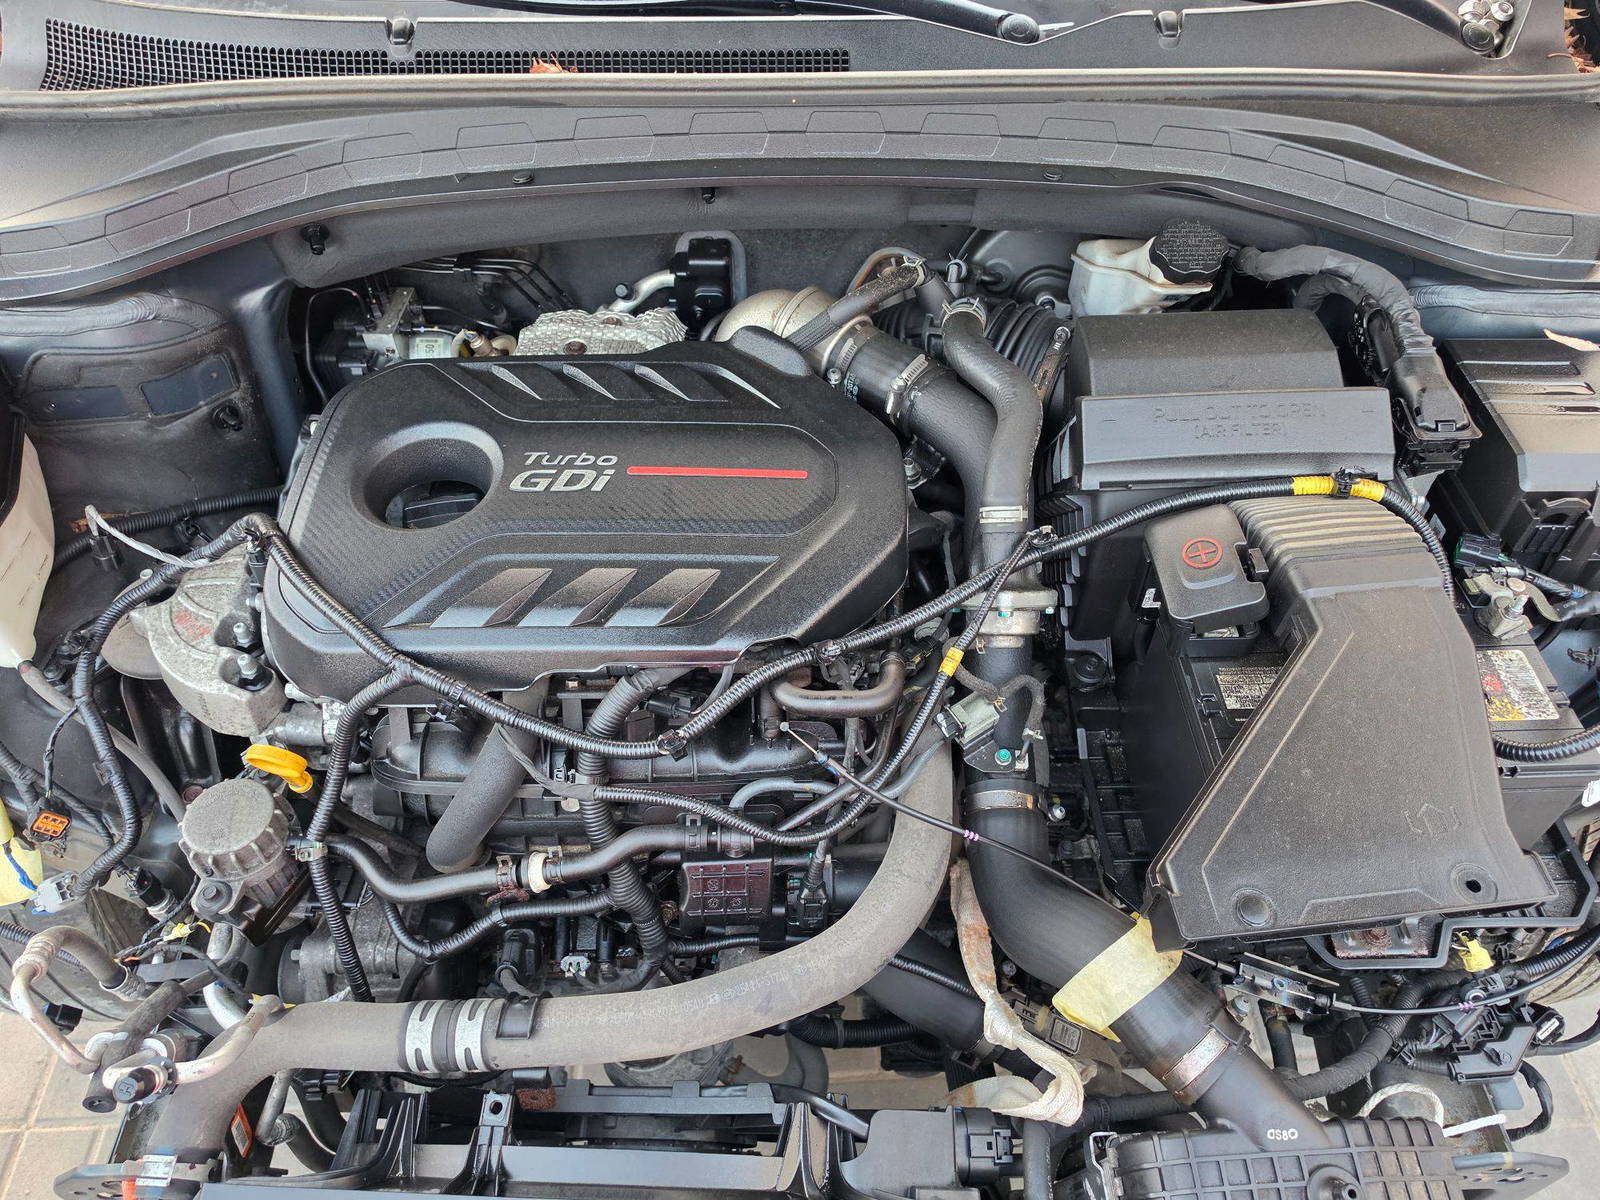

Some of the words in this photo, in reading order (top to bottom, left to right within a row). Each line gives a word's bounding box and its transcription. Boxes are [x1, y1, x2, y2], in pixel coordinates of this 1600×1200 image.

[1154, 408, 1201, 422] PULL
[1205, 406, 1242, 420] OUT
[1246, 404, 1273, 418] TO
[1276, 402, 1327, 418] OPEN
[523, 451, 619, 466] Turbo
[508, 468, 617, 493] GDi
